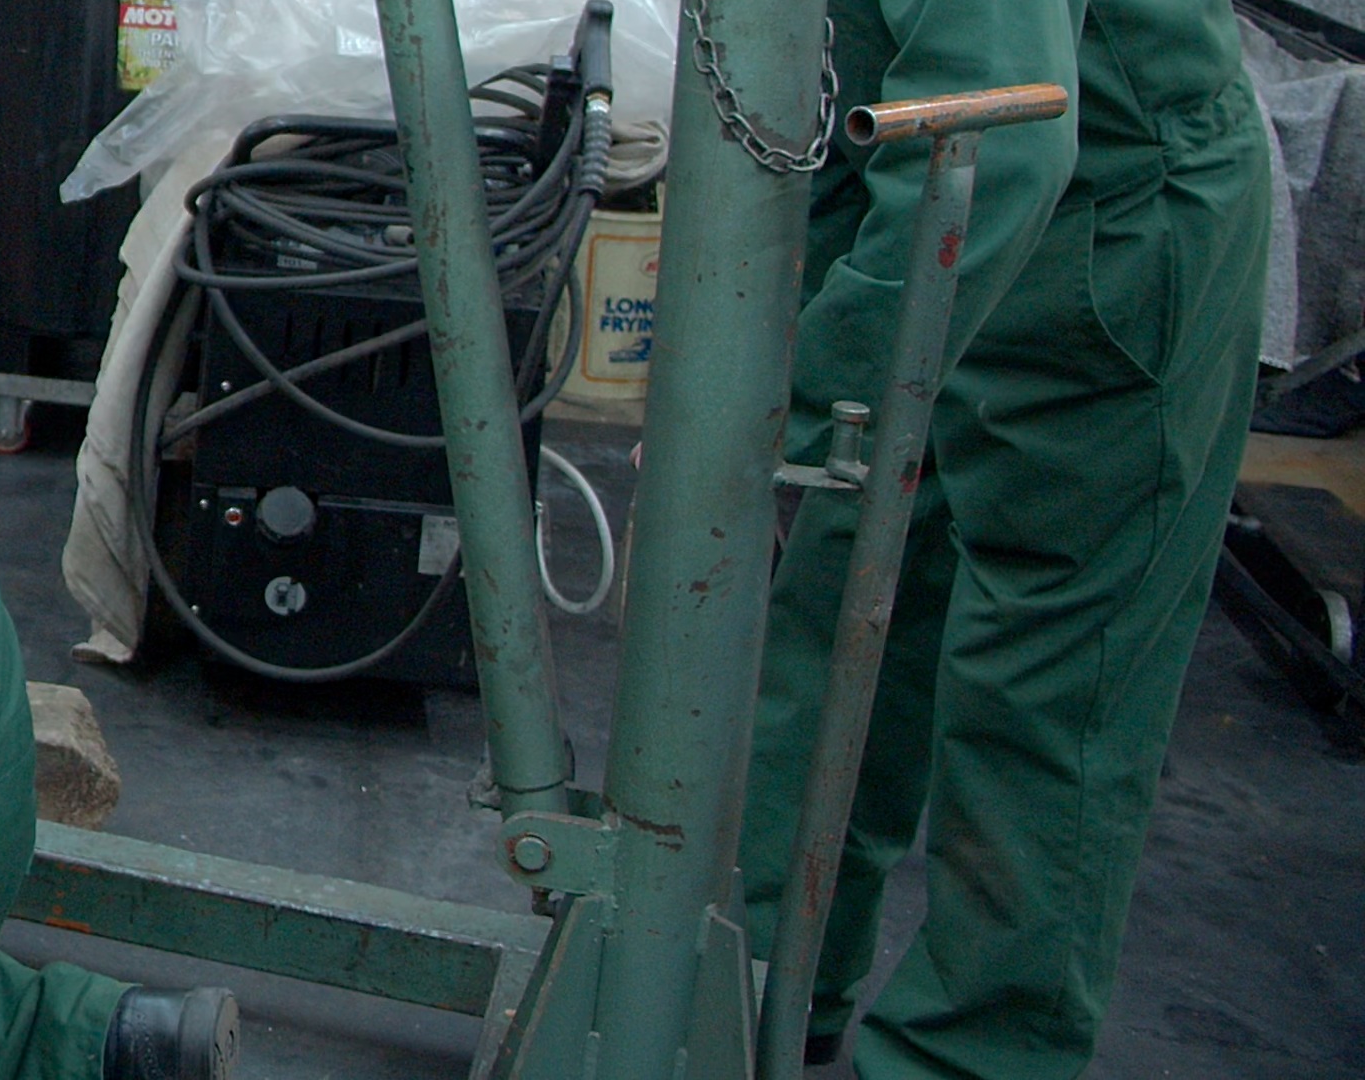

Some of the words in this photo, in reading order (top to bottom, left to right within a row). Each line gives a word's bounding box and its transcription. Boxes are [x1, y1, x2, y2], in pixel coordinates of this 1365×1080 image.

[123, 6, 174, 25] MOT
[151, 32, 178, 47] PA
[605, 296, 654, 314] LON
[599, 315, 653, 332] FRYIN
